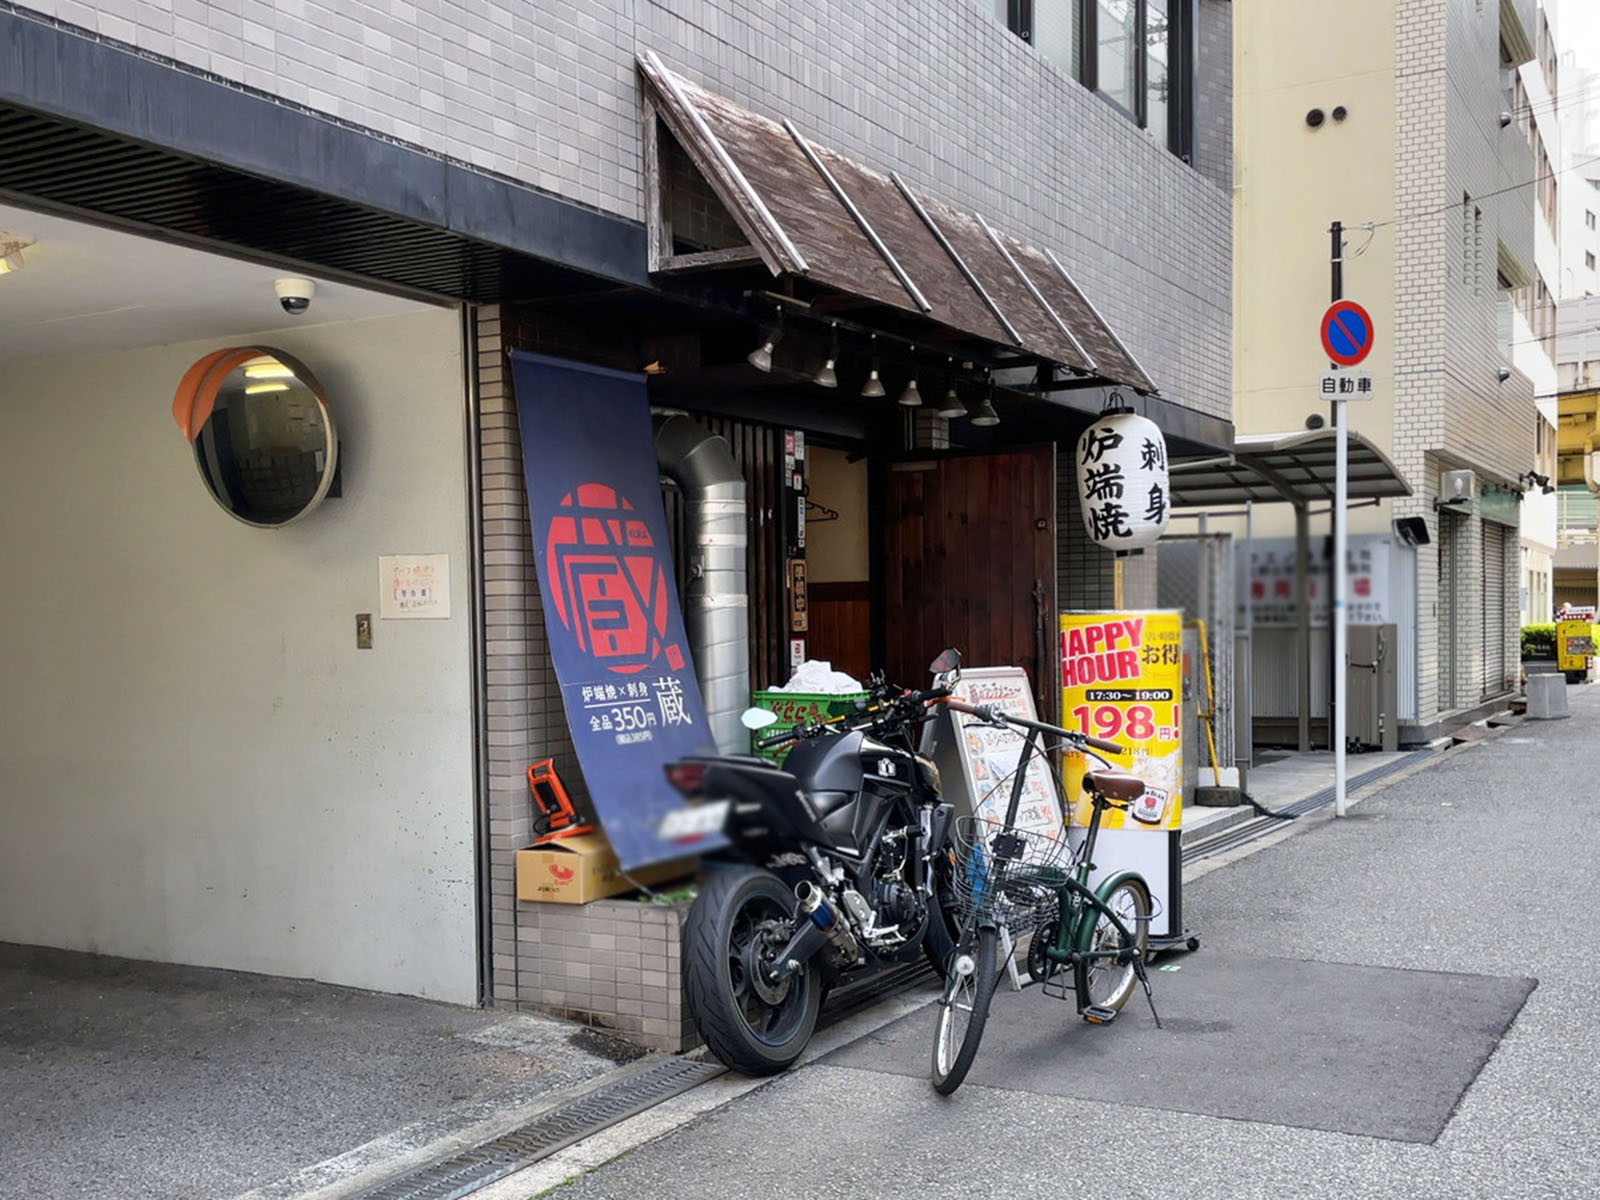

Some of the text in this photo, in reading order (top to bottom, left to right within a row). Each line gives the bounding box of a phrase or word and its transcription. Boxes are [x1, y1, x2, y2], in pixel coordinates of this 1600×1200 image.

[1322, 377, 1372, 394] 自動車
[1081, 427, 1133, 541] 炉端焼
[1140, 437, 1166, 525] 刺身
[1062, 650, 1140, 687] HOUR
[652, 677, 692, 727] 蔵
